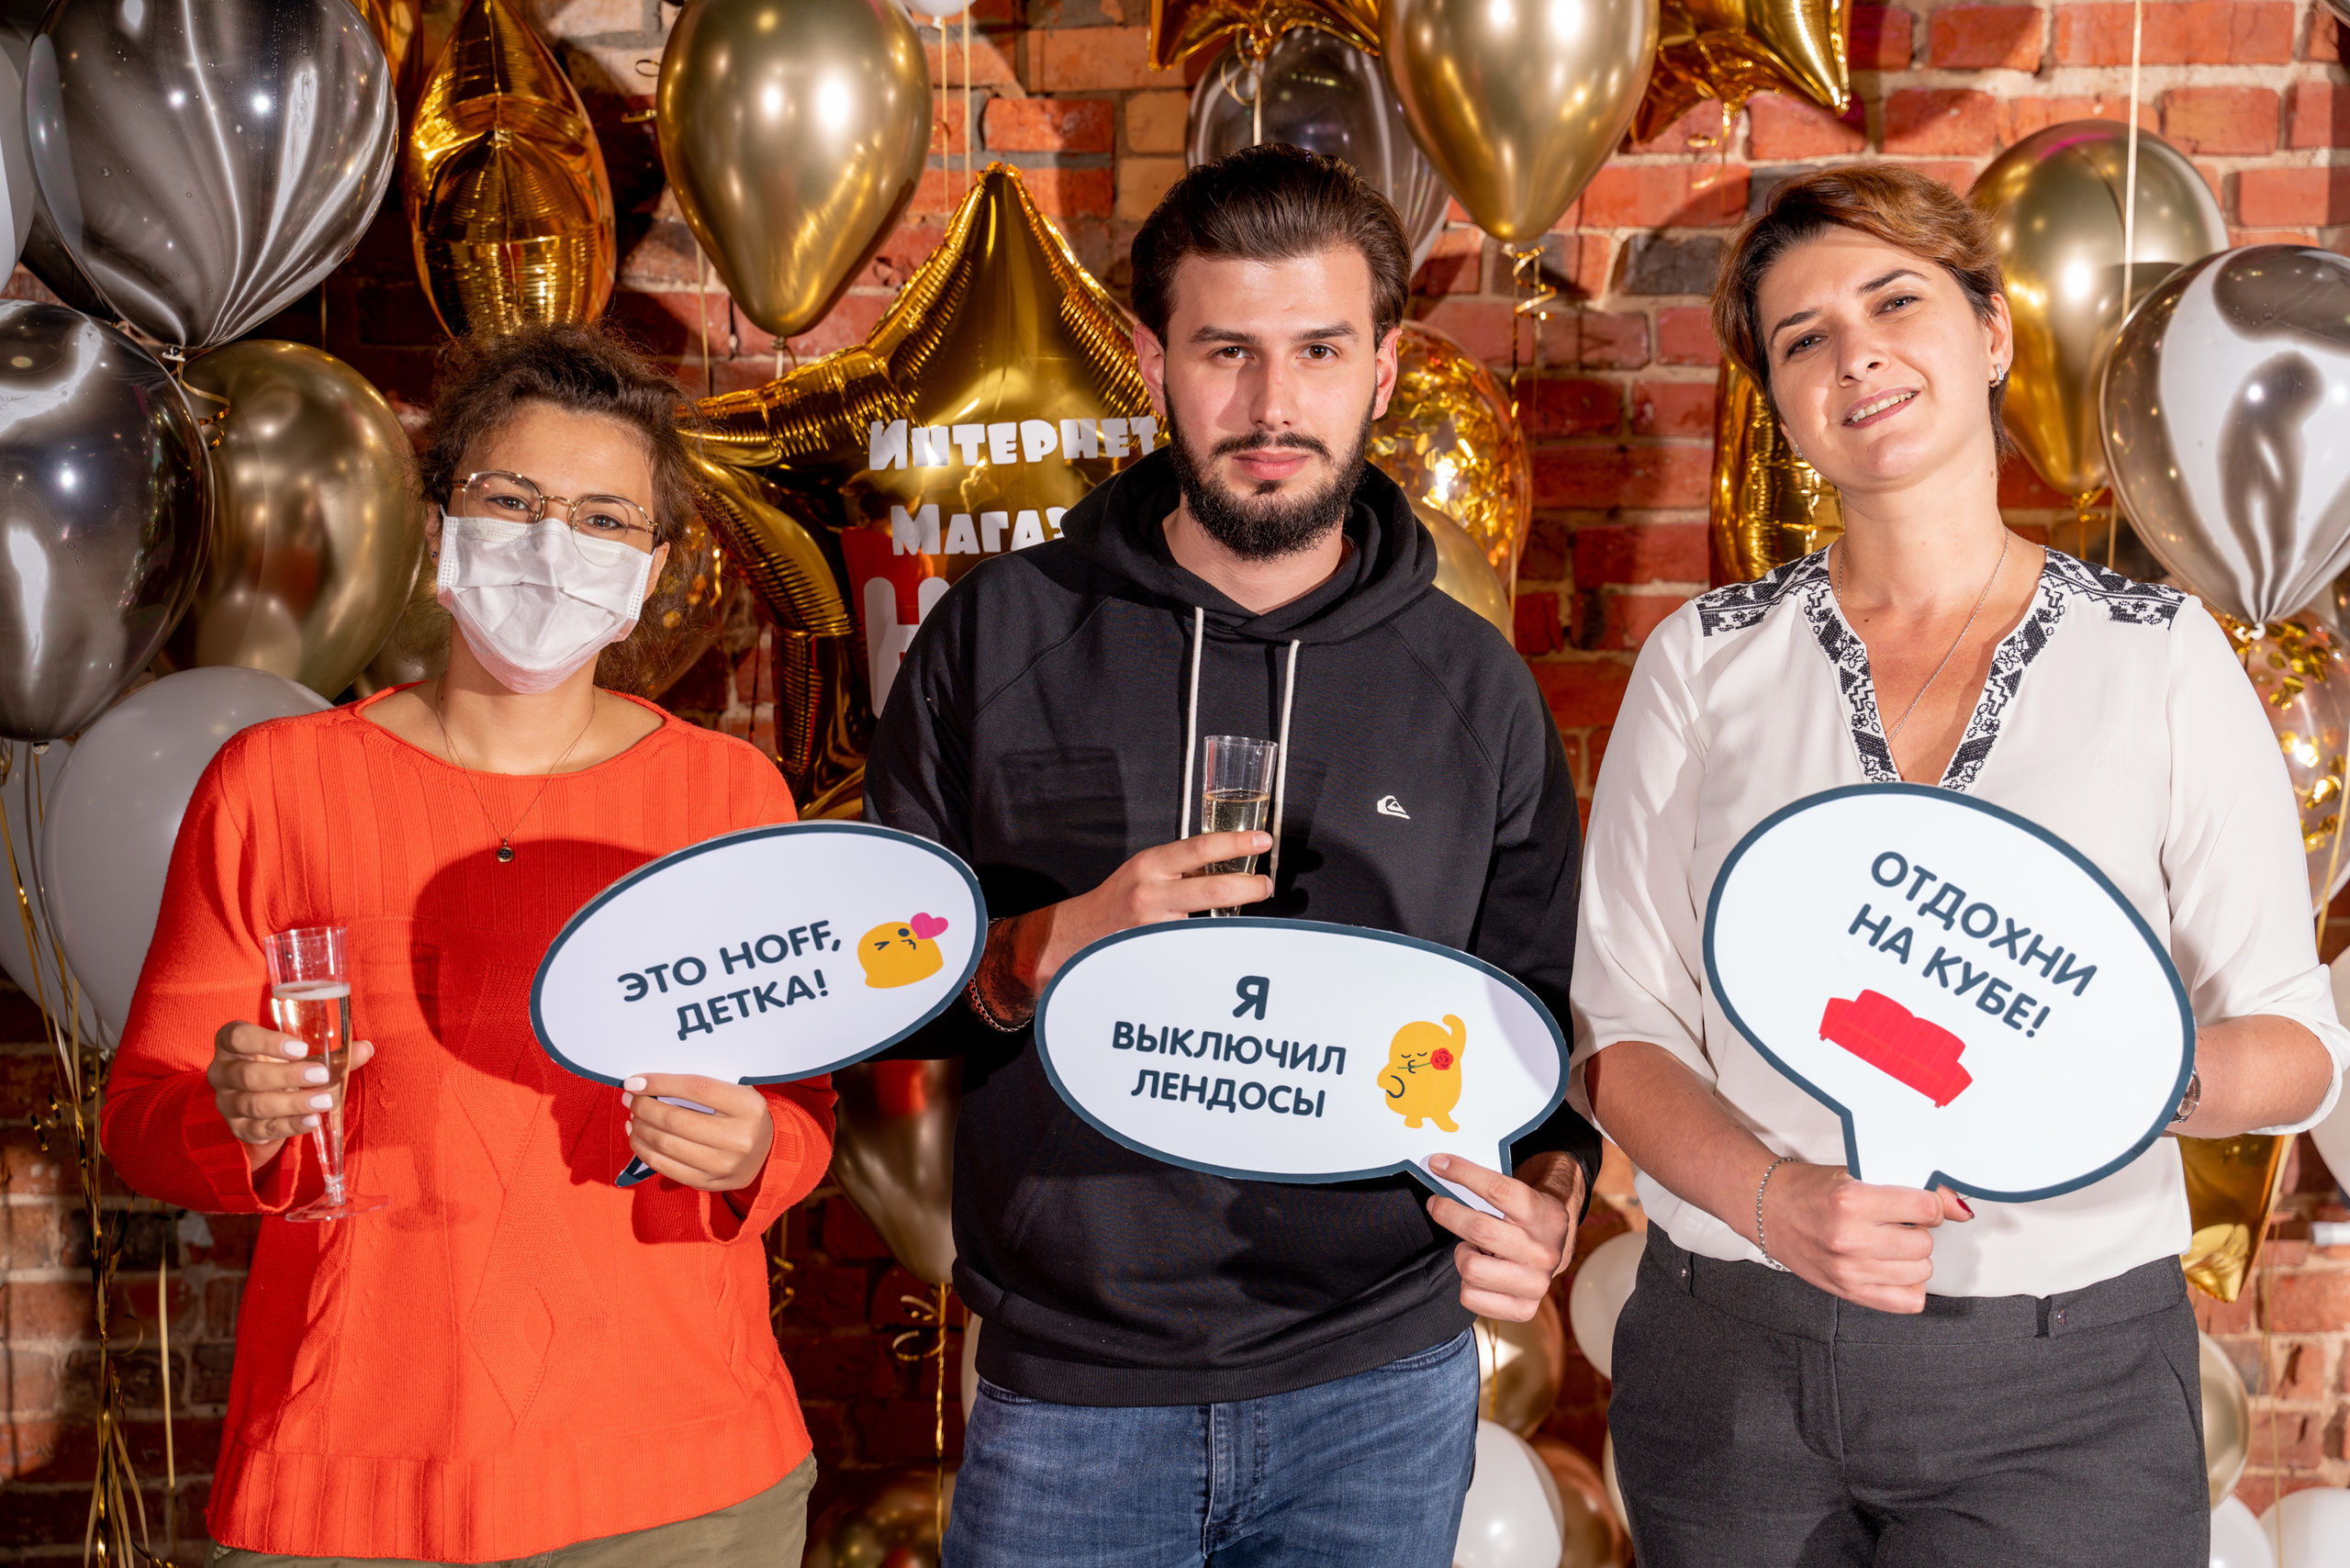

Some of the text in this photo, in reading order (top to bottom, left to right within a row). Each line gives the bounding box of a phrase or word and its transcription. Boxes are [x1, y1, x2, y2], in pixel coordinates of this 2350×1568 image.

[1871, 851, 2098, 997] ОТДОХНИ
[617, 920, 842, 1002] ЭТО HOFF,
[1848, 903, 2051, 1038] НА КУБЕ!
[677, 969, 829, 1041] ДЕТКА!
[1232, 975, 1270, 1021] Я
[1112, 1020, 1347, 1076] ВЫКЛЮЧИЛ
[1130, 1069, 1326, 1118] ЛЕНДОСЫ
